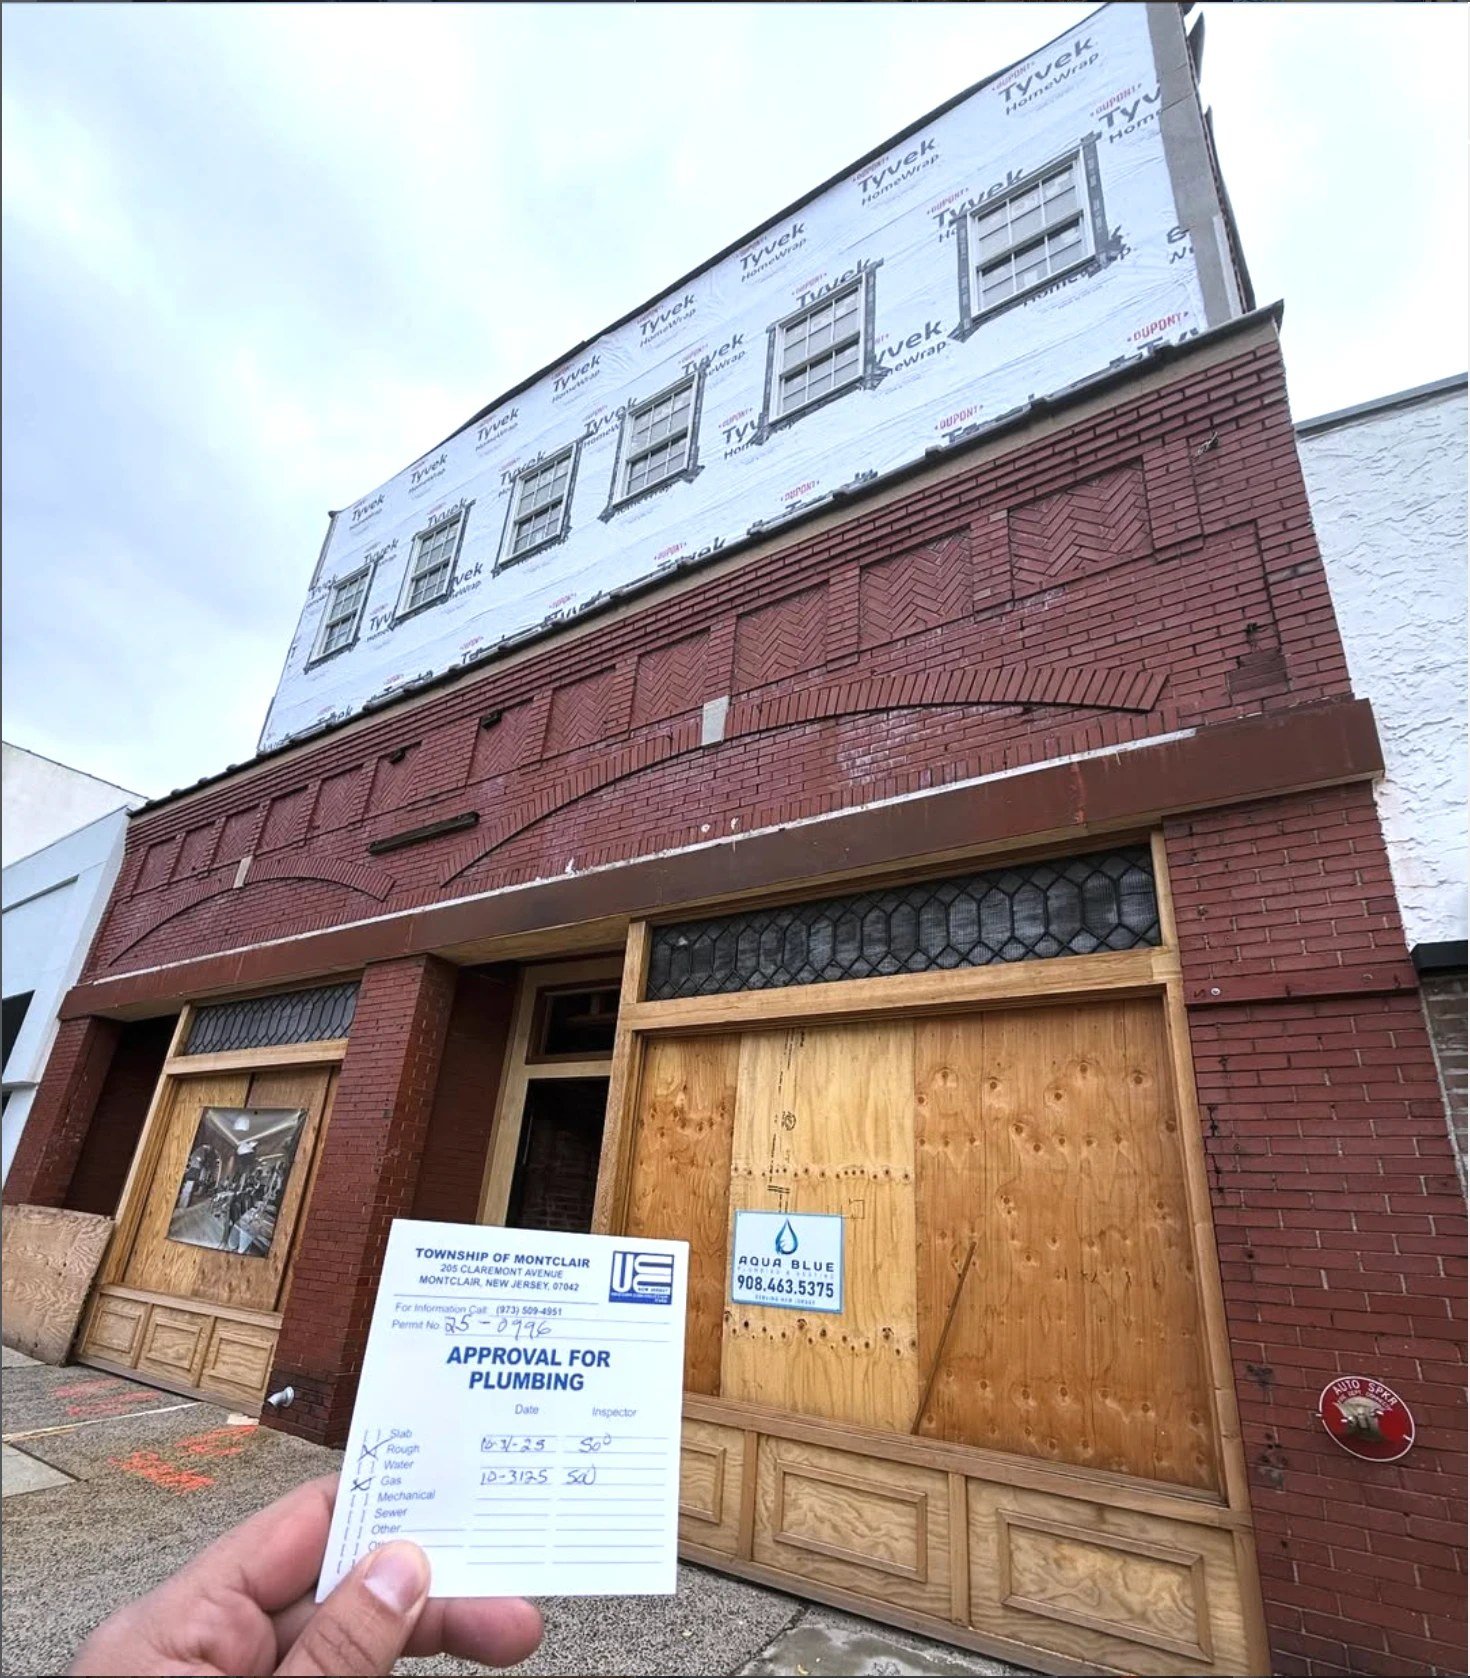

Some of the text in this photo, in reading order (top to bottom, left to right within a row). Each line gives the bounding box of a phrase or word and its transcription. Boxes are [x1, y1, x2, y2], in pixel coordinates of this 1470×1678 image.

[999, 37, 1093, 102] Tyvek
[1006, 52, 1099, 115] HomeWrap
[858, 137, 936, 193] Tyvek
[862, 154, 939, 205] HomeWrap
[740, 223, 806, 271] Tyvek
[741, 238, 807, 283] HomeWrap
[640, 294, 695, 335] Tyvek
[640, 308, 696, 347] HomeWrap
[1133, 311, 1182, 342] DUPONT
[553, 354, 600, 392] Tyvek
[477, 408, 520, 441] Tyvek
[939, 406, 978, 429] DUPONT
[411, 454, 448, 484] Tyvek
[416, 1248, 590, 1268] TOWNSHIP OF MONTCLAIR
[739, 1256, 834, 1272] AQUA BLUE
[440, 1263, 563, 1279] 205 CLAREMONT AVENUE
[419, 1275, 579, 1291] MONTCLAIR, NEW JERSEY, 07042
[737, 1275, 834, 1298] 908.463.5375
[395, 1302, 411, 1312] For
[414, 1303, 467, 1314] Information
[496, 1305, 519, 1316] (973)
[522, 1306, 562, 1316] 509-4951
[392, 1318, 424, 1329] Permit
[446, 1346, 611, 1368] APPROVAL FOR
[468, 1371, 585, 1391] PLUMBING
[1332, 1379, 1360, 1396] AUTO
[1368, 1382, 1398, 1406] SPKR
[515, 1403, 637, 1418] Date Inspector
[390, 1428, 412, 1438] Slab
[386, 1444, 420, 1456] Rough
[384, 1460, 414, 1470] Water
[380, 1475, 402, 1486] Gas
[377, 1489, 436, 1503] Mechanical
[374, 1507, 408, 1519] Sewer
[371, 1523, 402, 1535] Other
